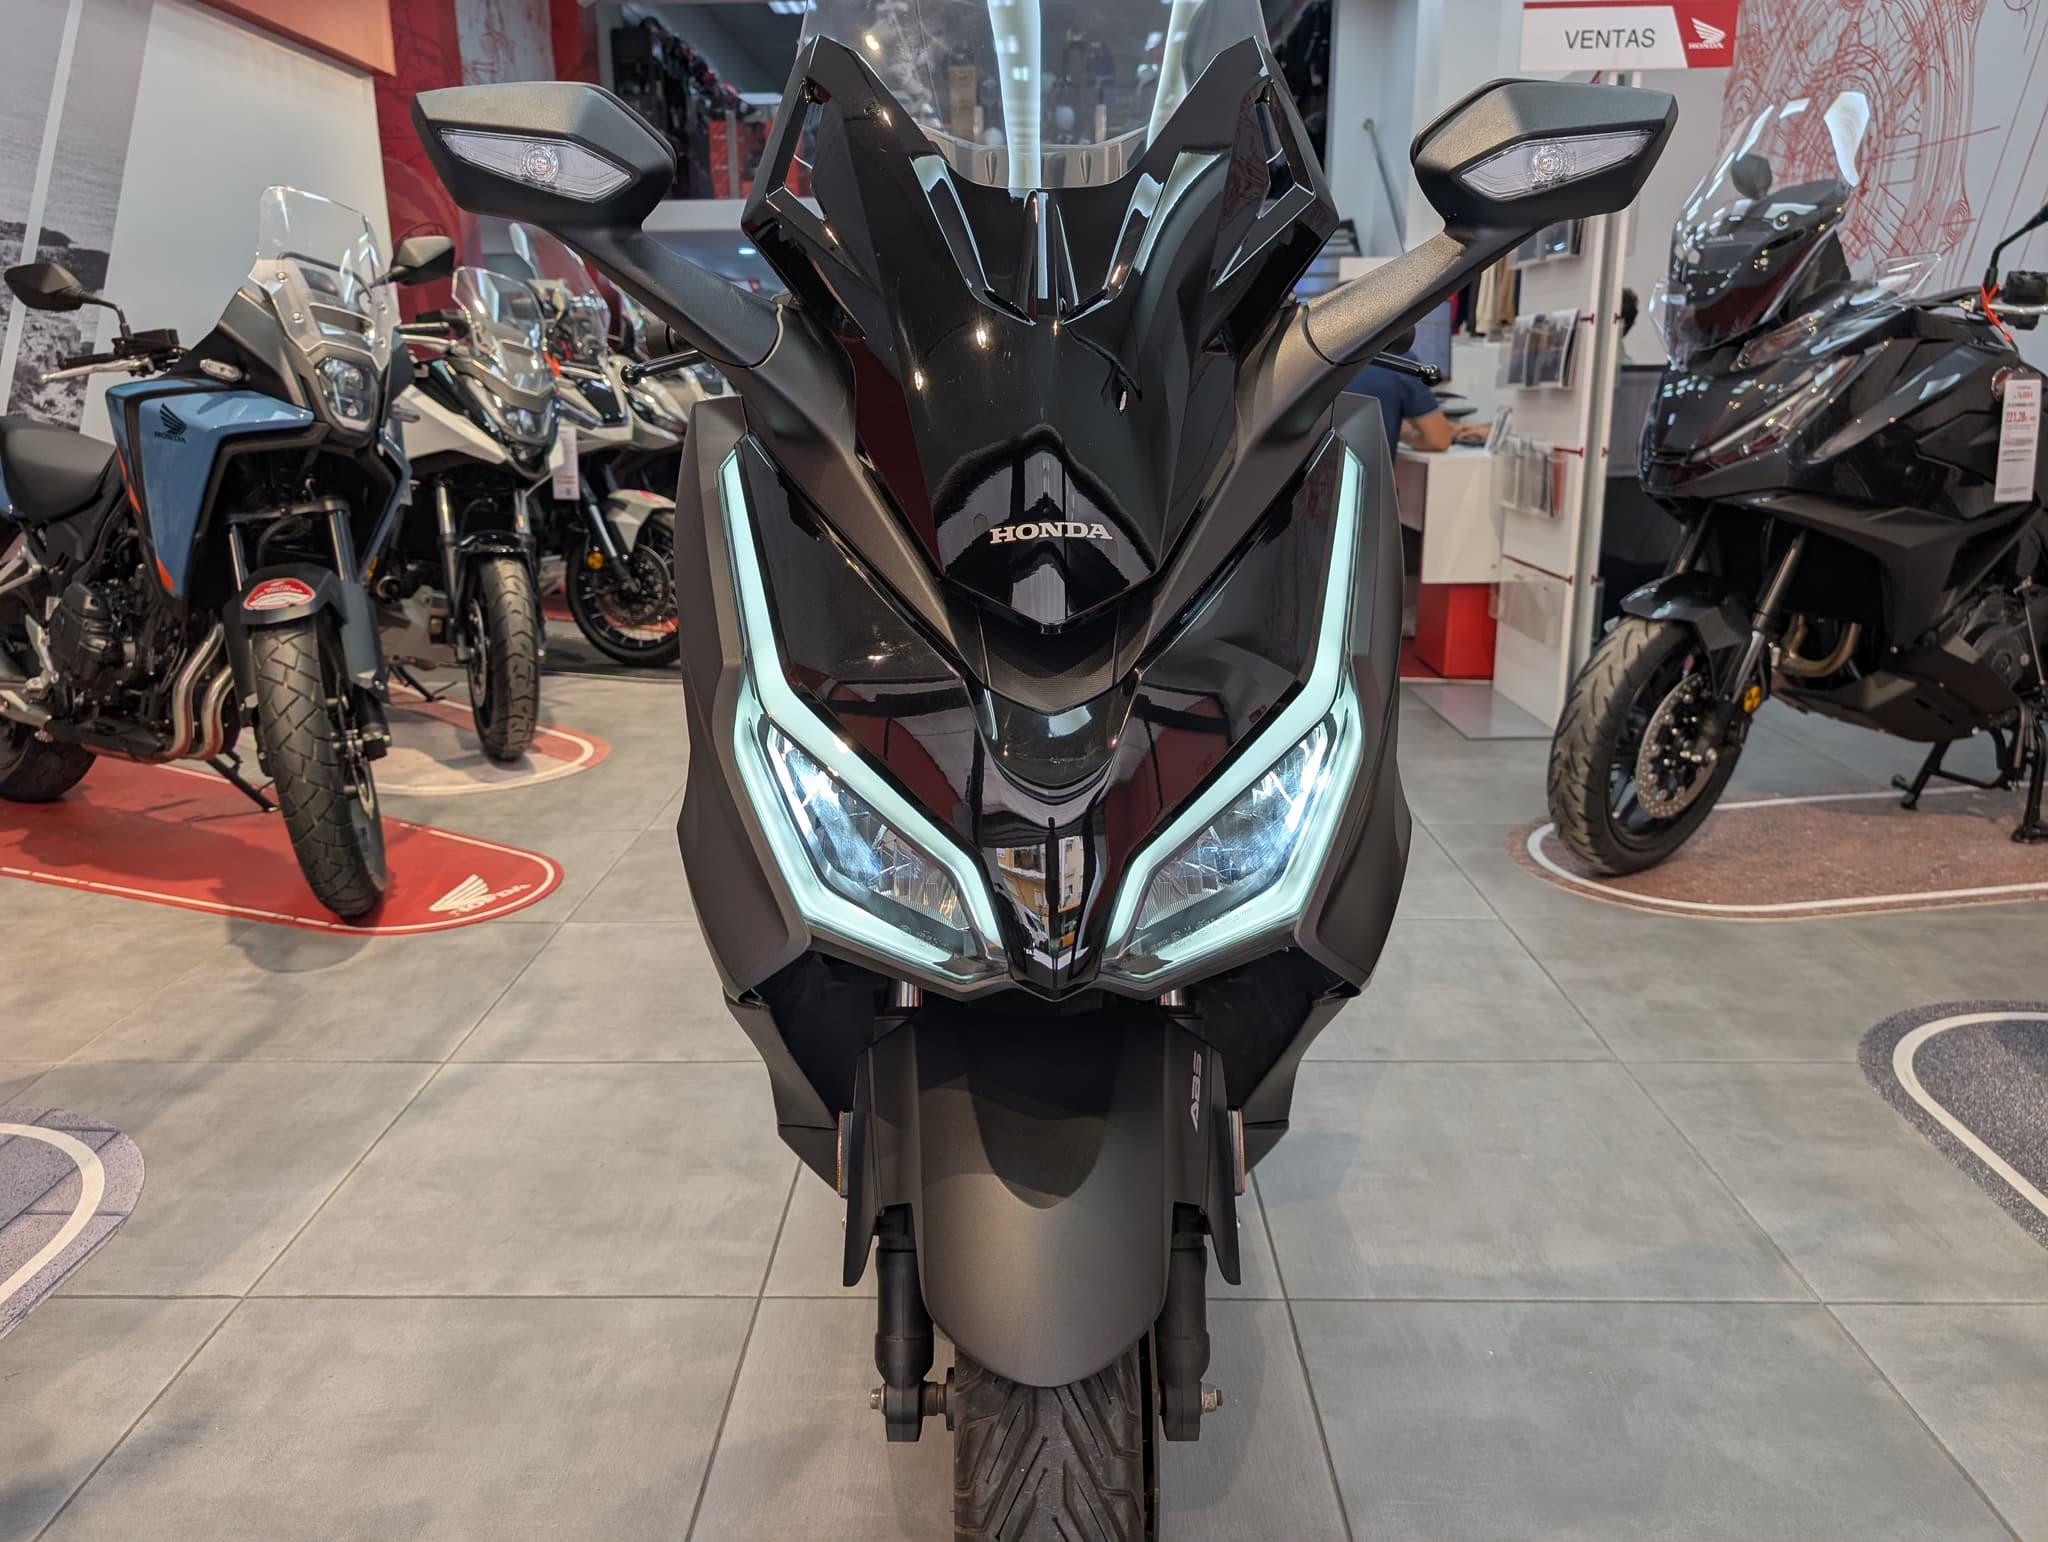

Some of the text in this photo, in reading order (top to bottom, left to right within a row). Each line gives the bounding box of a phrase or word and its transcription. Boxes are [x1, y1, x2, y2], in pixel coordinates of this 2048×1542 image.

[1564, 28, 1656, 50] VENTAS
[1688, 41, 1725, 50] HONDA
[989, 521, 1113, 544] HONDA
[1190, 1050, 1202, 1133] ABS
